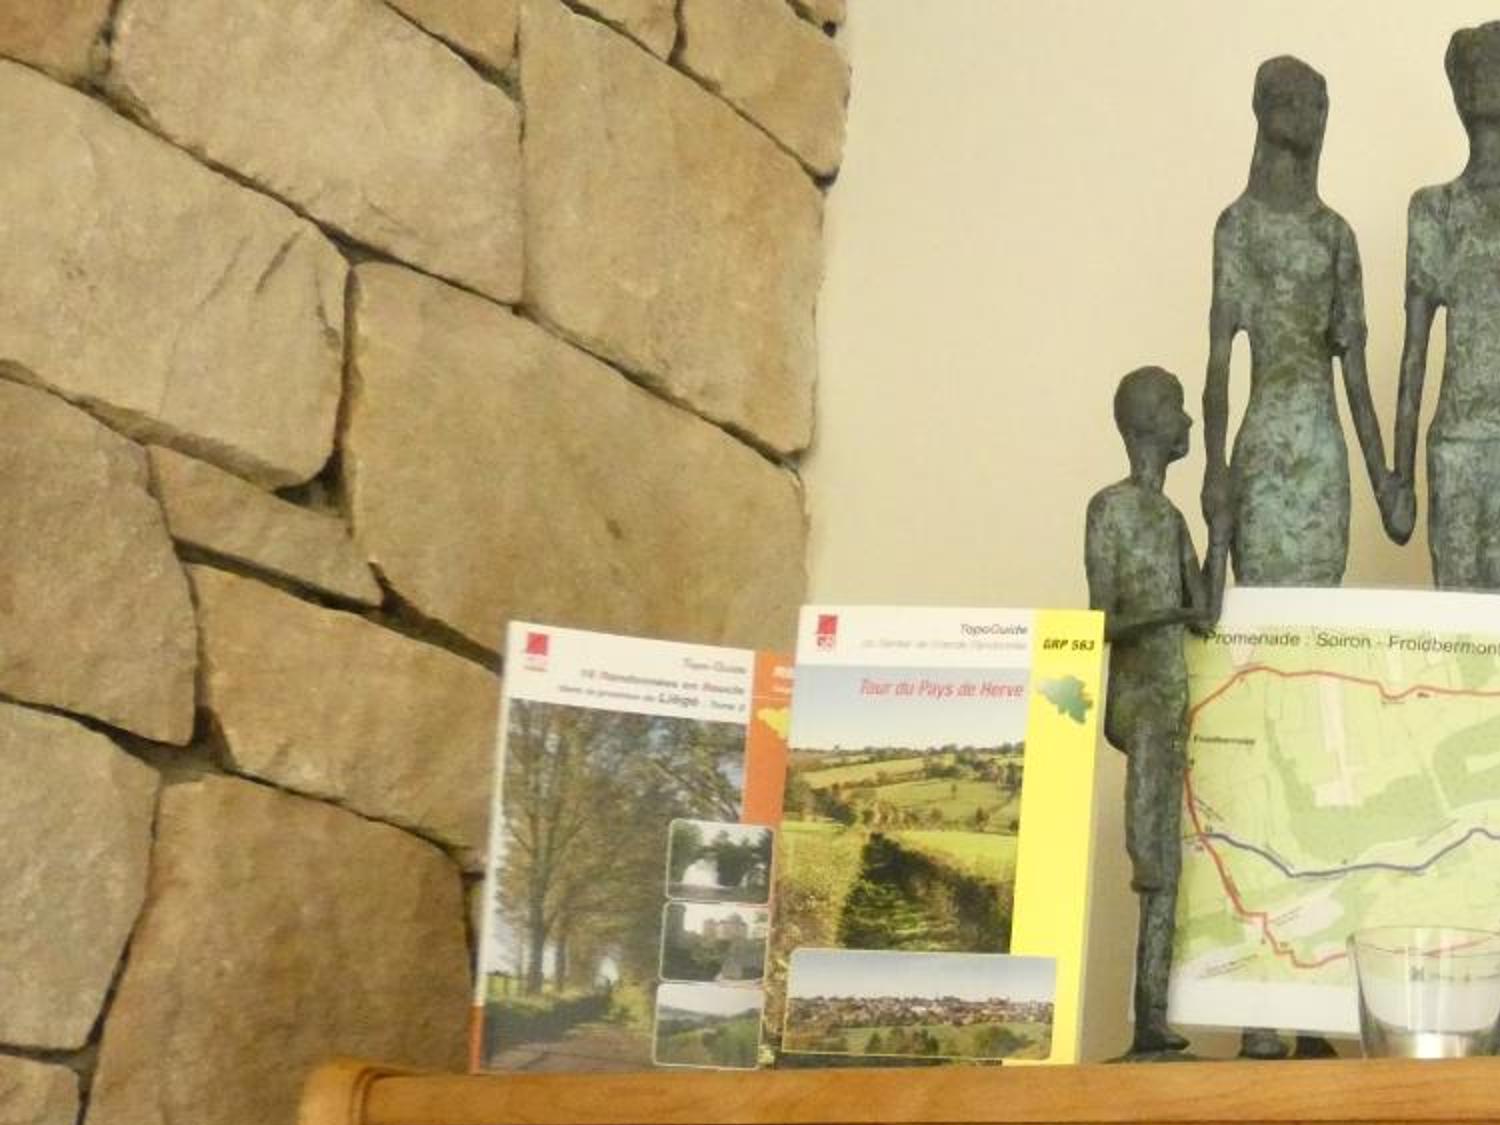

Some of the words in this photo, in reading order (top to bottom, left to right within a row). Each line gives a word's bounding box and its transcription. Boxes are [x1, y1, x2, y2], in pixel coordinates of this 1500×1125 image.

[1043, 639, 1068, 651] GRP
[1203, 631, 1299, 647] Promenade
[1316, 632, 1371, 648] Soiron
[860, 677, 890, 695] Tour
[895, 680, 914, 695] du
[918, 679, 953, 698] Pays
[957, 680, 976, 695] de
[979, 680, 1024, 697] Herve
